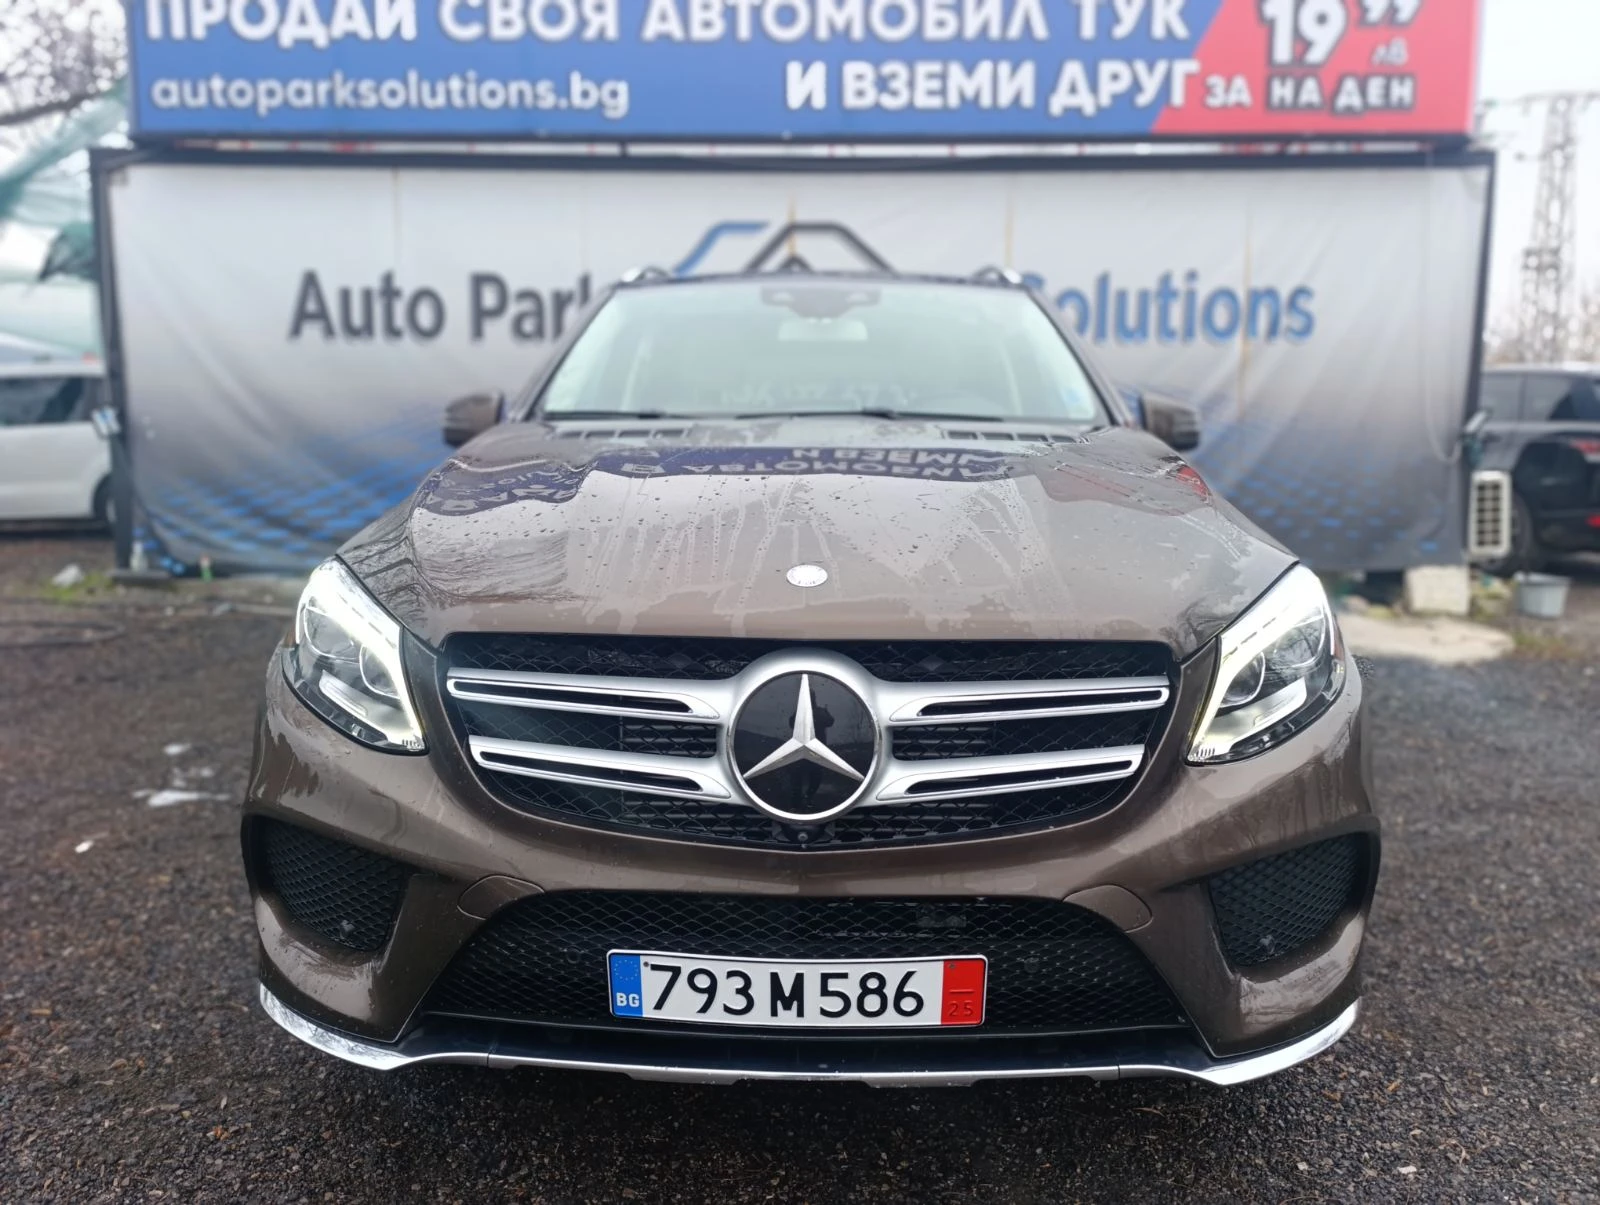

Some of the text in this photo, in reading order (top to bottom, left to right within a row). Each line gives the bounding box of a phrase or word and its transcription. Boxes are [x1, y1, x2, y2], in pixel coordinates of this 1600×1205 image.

[439, 0, 619, 41] СВОЯ
[641, 0, 1049, 41] АВТОМОБИЛ
[1071, 0, 1190, 40] ТУК
[152, 70, 629, 119] autoparksolutions.bg
[786, 59, 1200, 117] И ВЗЕМИ ДРУГ
[1205, 75, 1415, 113] ЗА НА ДЕН
[288, 269, 446, 340] Auto
[616, 992, 640, 1008] BG
[650, 963, 755, 1016] 793
[819, 970, 925, 1019] 586
[947, 1000, 974, 1017] 25
